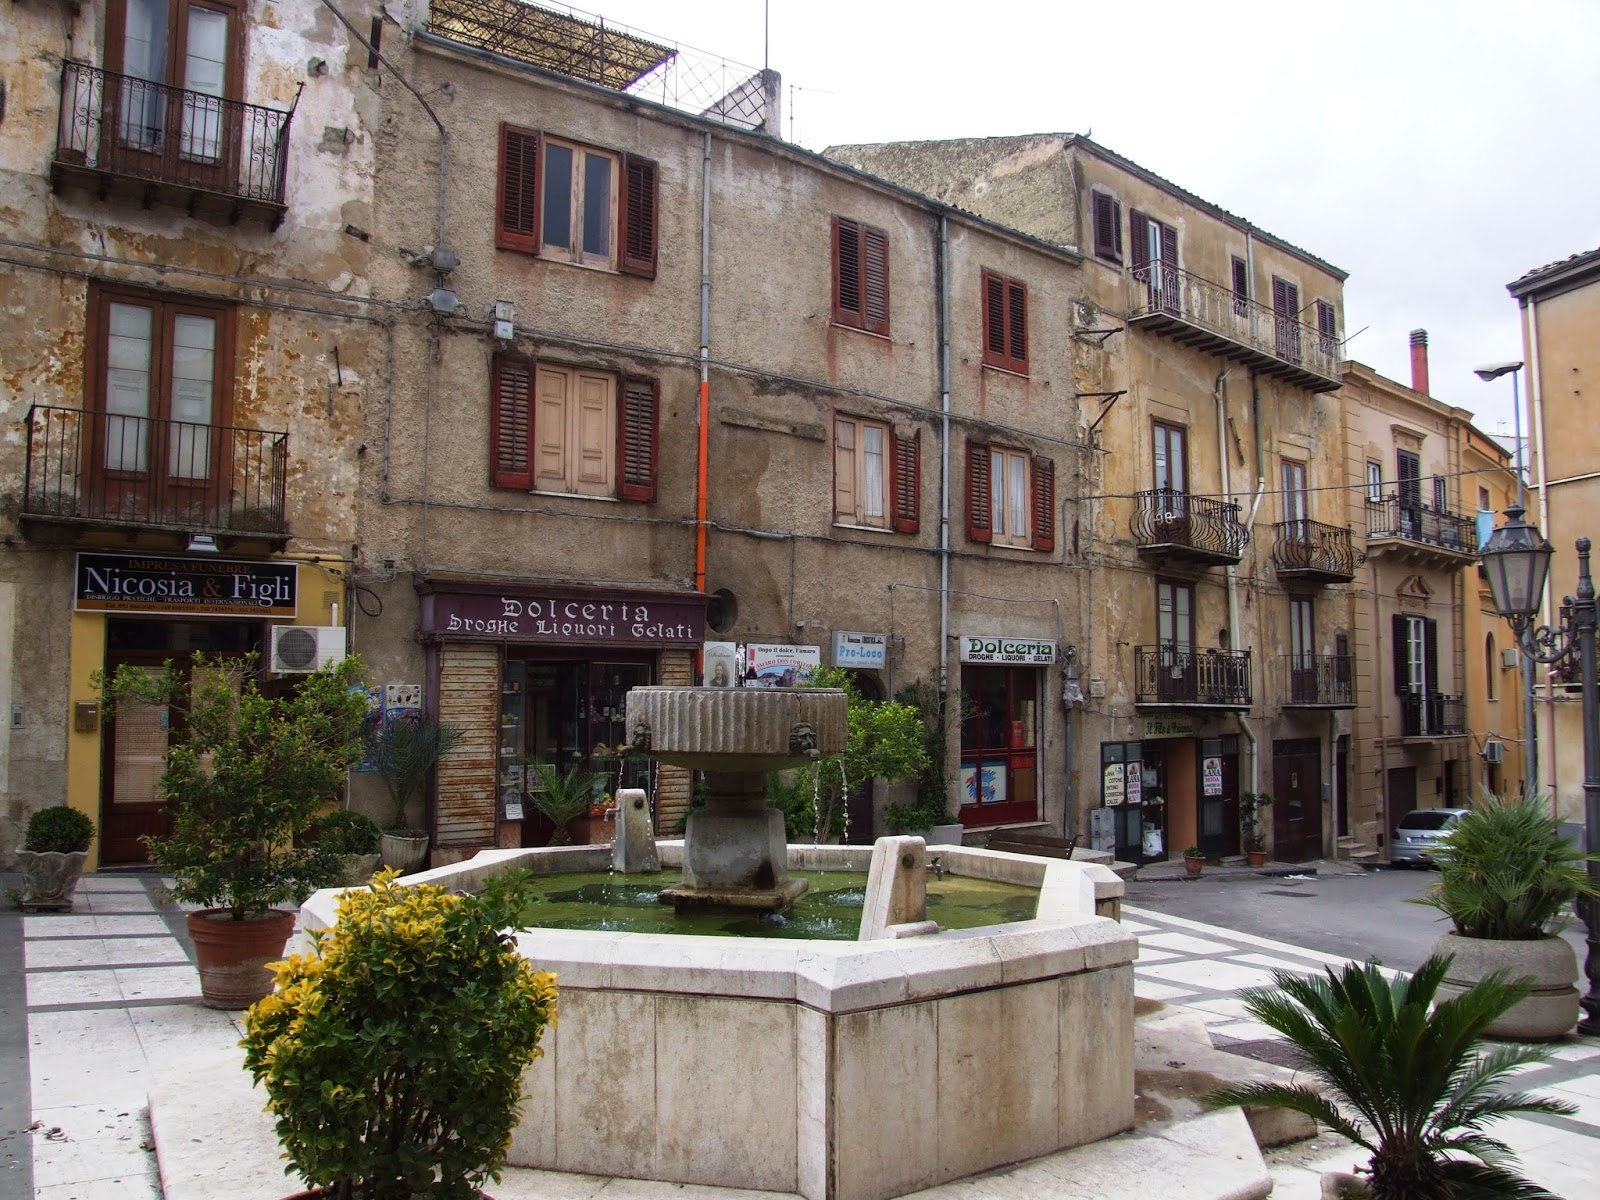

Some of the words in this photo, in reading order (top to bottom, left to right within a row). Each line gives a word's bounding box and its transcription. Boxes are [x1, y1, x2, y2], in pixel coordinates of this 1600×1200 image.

[128, 559, 187, 571] IMPRESA
[191, 562, 251, 574] FUNEBRE
[83, 567, 195, 597] Nicosia
[202, 577, 222, 598] &
[231, 574, 290, 607] Figli
[502, 597, 649, 622] Dolceria
[537, 619, 615, 637] Liquori
[631, 622, 693, 639] Gelati
[758, 646, 773, 654] Dopo
[839, 645, 882, 659] Pro-Loco
[969, 639, 1053, 655] Dolceria
[756, 659, 776, 670] AMARO
[969, 653, 994, 661] DROGHE
[1001, 654, 1026, 662] LIQUORI
[1203, 769, 1221, 777] LANA
